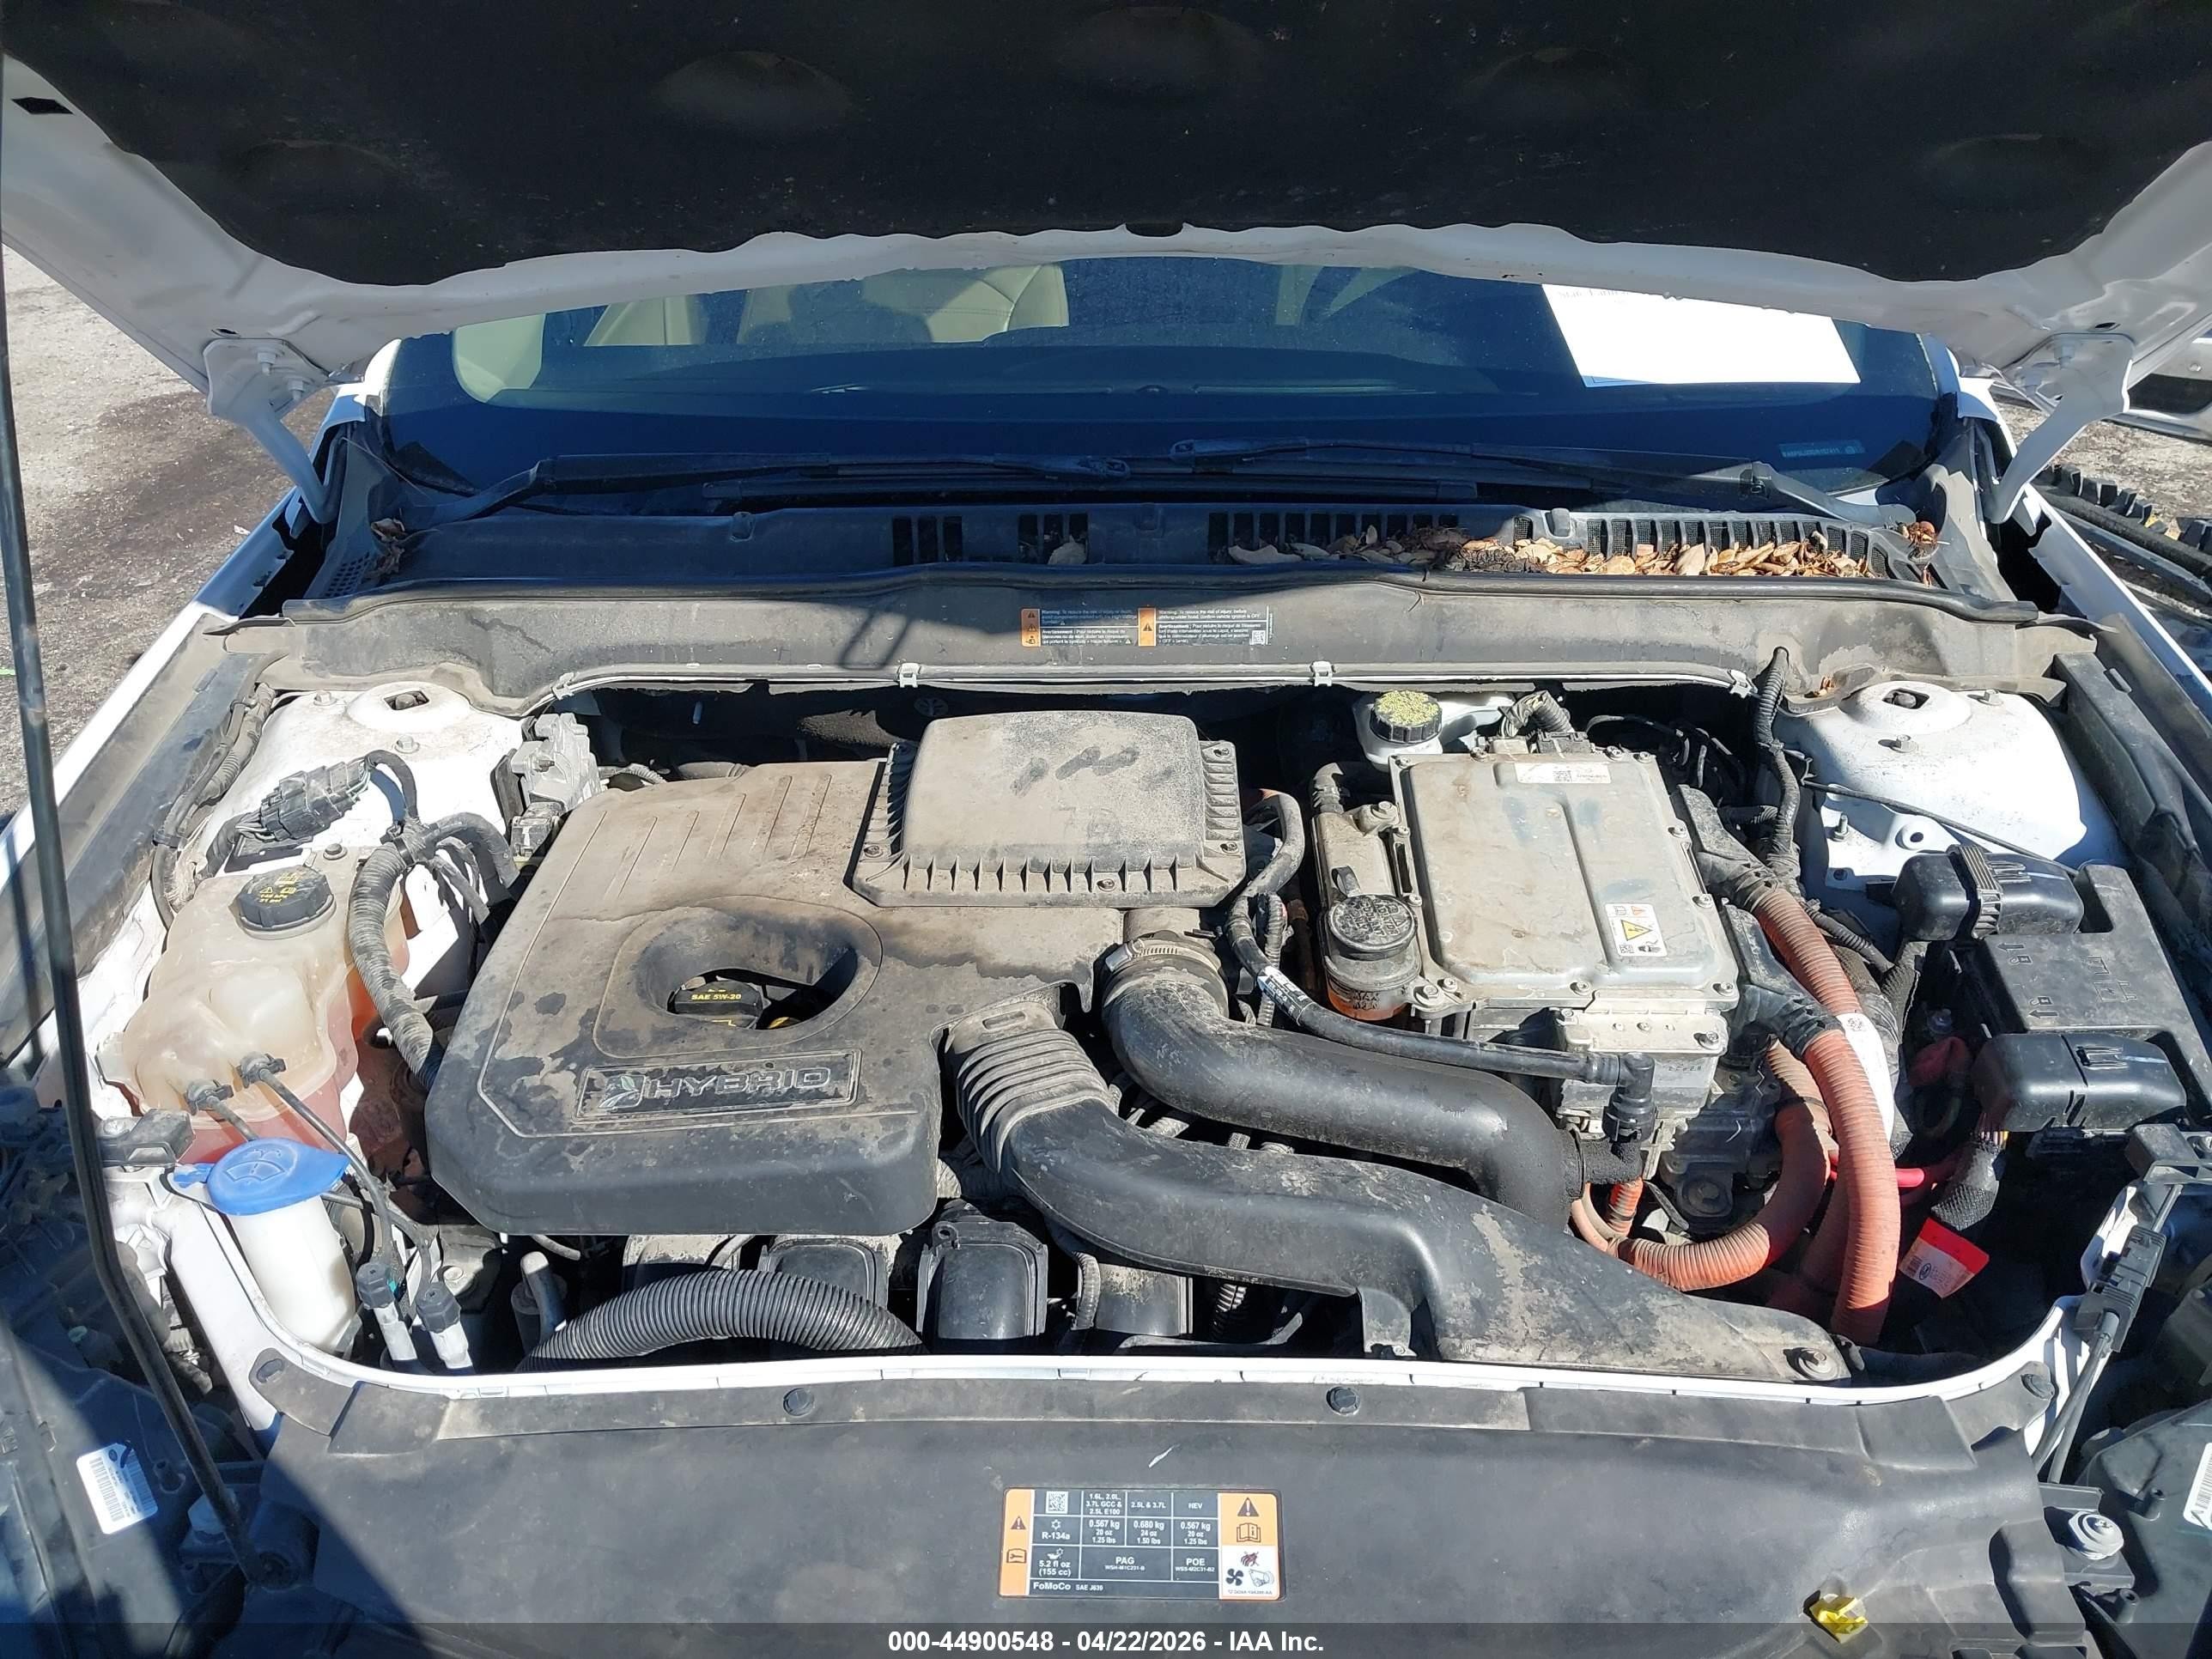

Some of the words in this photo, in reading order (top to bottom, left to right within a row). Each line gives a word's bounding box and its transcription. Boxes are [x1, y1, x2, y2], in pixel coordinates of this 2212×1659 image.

[649, 1067, 830, 1099] HYBRID
[1110, 1520, 1120, 1530] kg
[1155, 1521, 1165, 1531] kg
[1200, 1522, 1211, 1532] kg
[1042, 1531, 1071, 1540] R-134a
[1115, 1557, 1135, 1565] PAG
[1186, 1558, 1206, 1566] POE
[1038, 1568, 1057, 1577] (155
[1058, 1569, 1072, 1577] cc)
[1033, 1582, 1072, 1590] FoMoCo
